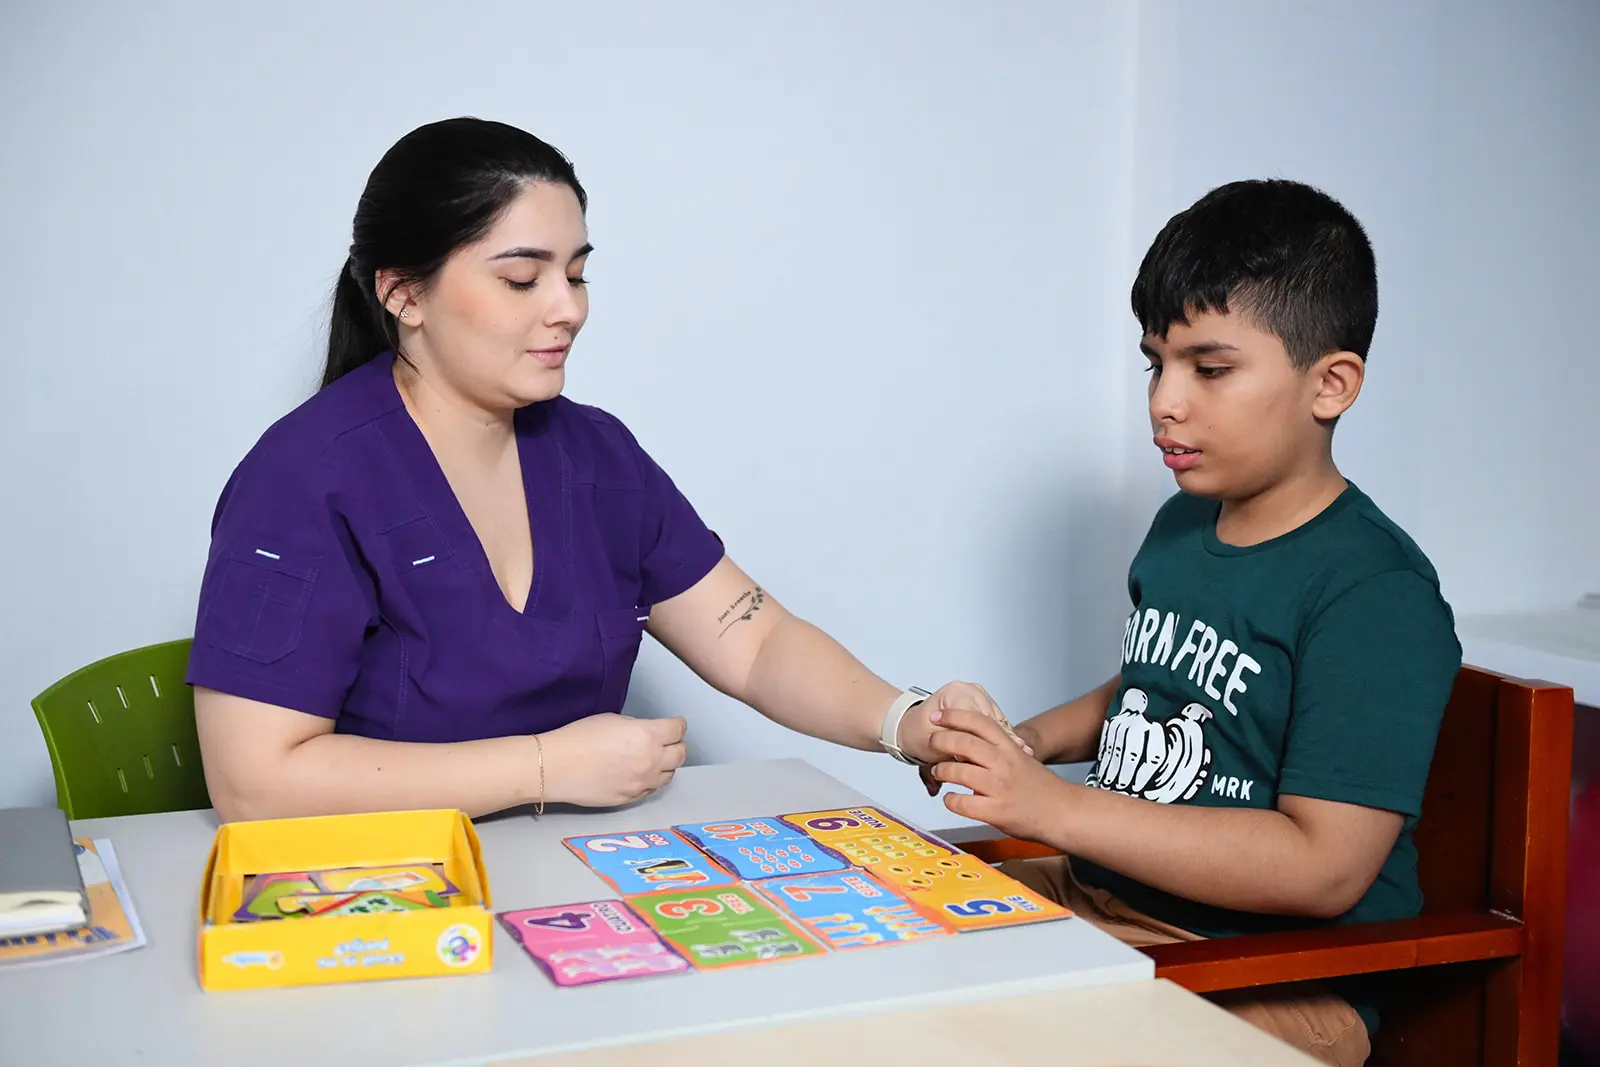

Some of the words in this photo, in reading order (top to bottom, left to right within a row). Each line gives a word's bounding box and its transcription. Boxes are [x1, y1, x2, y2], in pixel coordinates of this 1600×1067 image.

[1120, 608, 1180, 667] ORN
[1170, 619, 1262, 717] FREE
[1211, 774, 1254, 801] MRK
[847, 808, 889, 829] NUEVE
[702, 824, 756, 840] 10
[585, 835, 652, 852] 2
[782, 886, 846, 900] 7
[842, 876, 881, 896] SIETE
[658, 899, 720, 918] 3
[944, 899, 1012, 917] 5
[527, 912, 594, 930] 4
[592, 902, 634, 934] CUATRO
